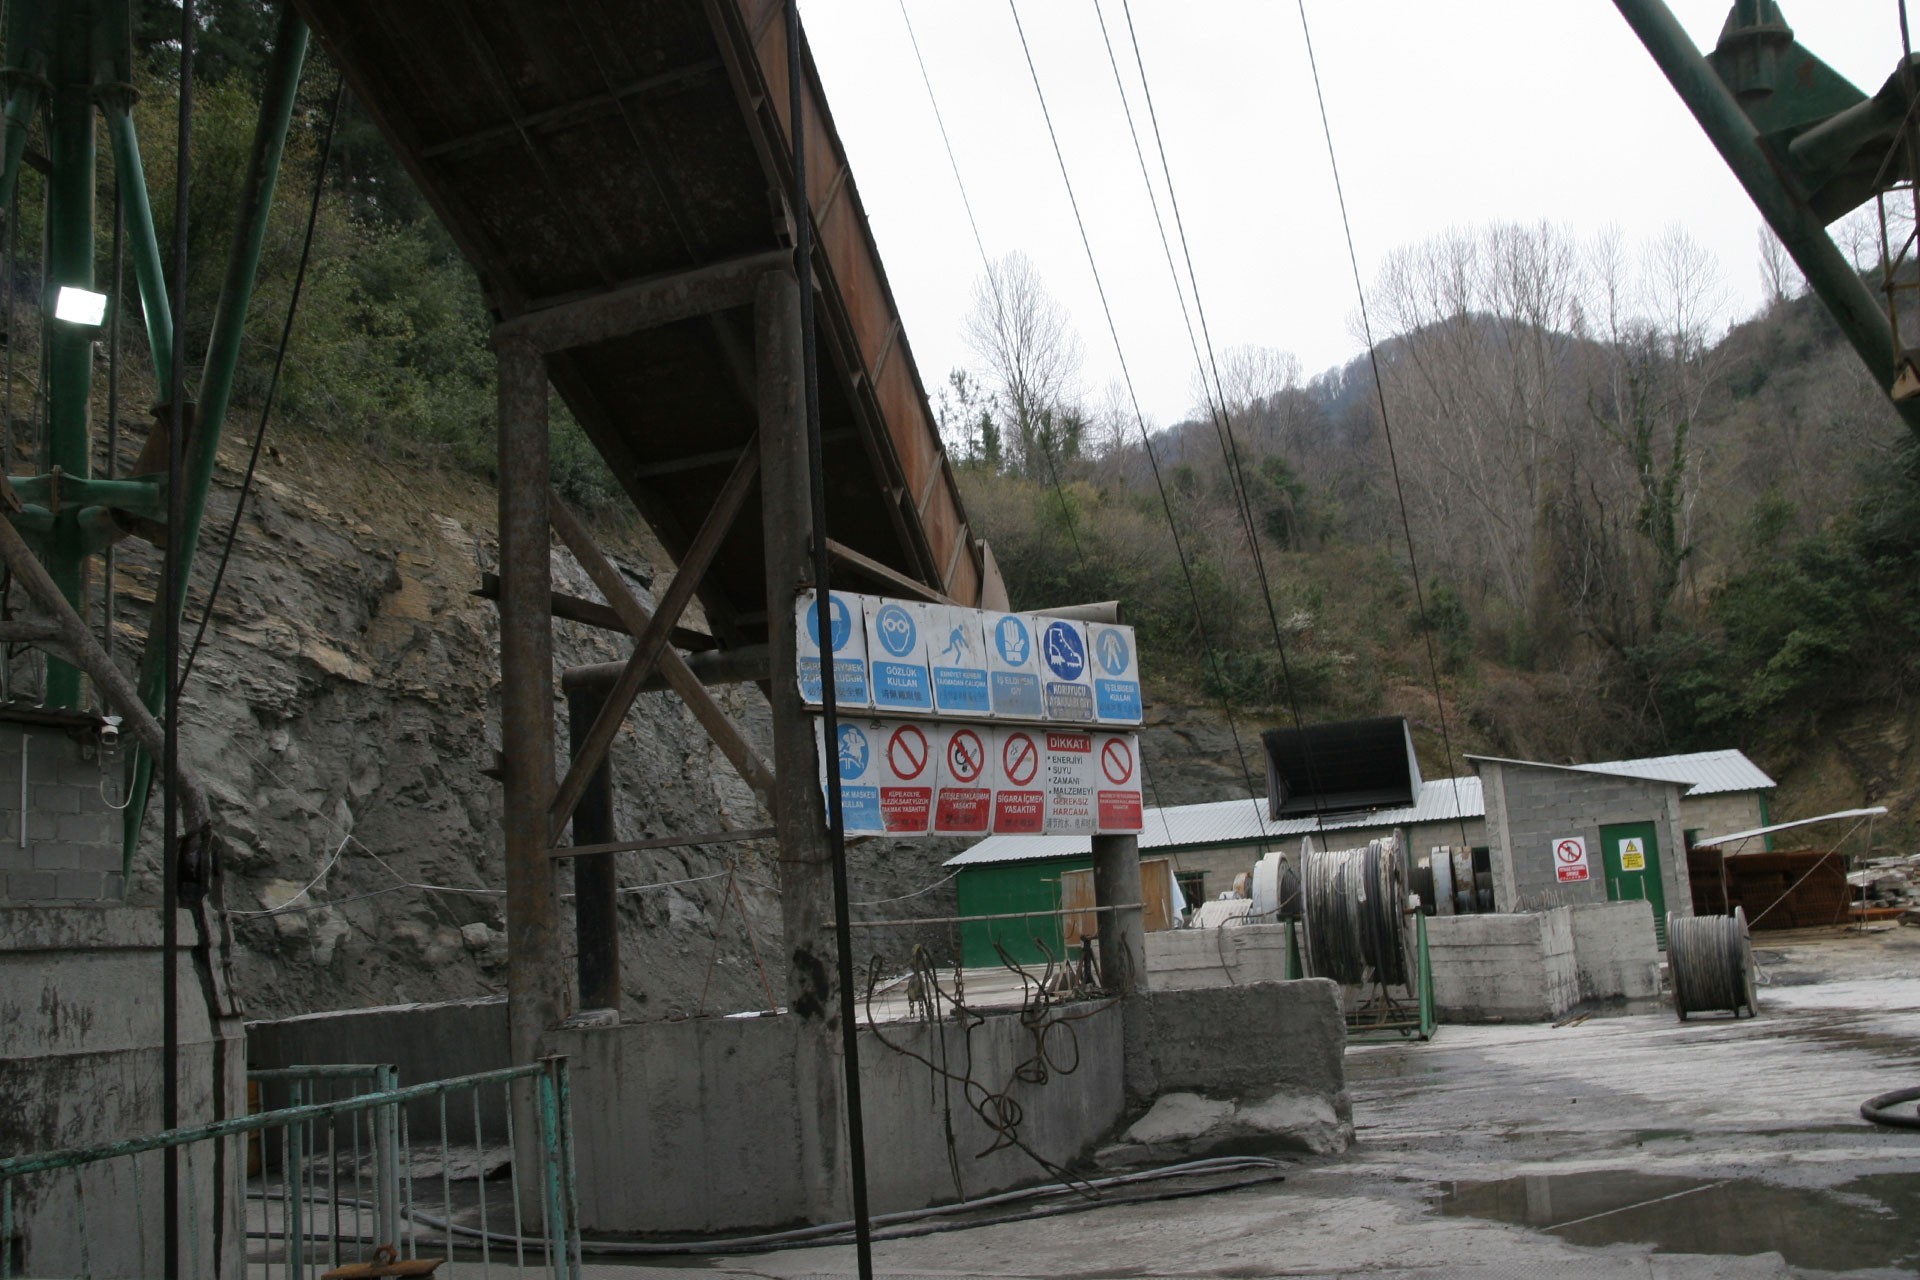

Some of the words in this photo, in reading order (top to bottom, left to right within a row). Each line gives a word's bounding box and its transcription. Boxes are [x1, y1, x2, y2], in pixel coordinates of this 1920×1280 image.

[886, 666, 917, 677] GÖZLÜK
[887, 677, 918, 688] KULLAN
[1053, 684, 1086, 697] KORUYUCU
[1050, 736, 1084, 749] DİKKAT
[1052, 755, 1083, 765] ENERJİYİ
[1053, 766, 1072, 775] SUYU
[1053, 776, 1080, 785] ZAMANI
[1053, 786, 1094, 796] MALZEMEYİ
[997, 793, 1023, 804] SİGARA
[1023, 793, 1043, 805] İÇMEK
[1053, 797, 1089, 806] GEREKSİZ
[952, 801, 977, 810] YASAKTIR
[1004, 805, 1036, 814] YASAKTIR
[1053, 807, 1089, 816] HARCAMA
